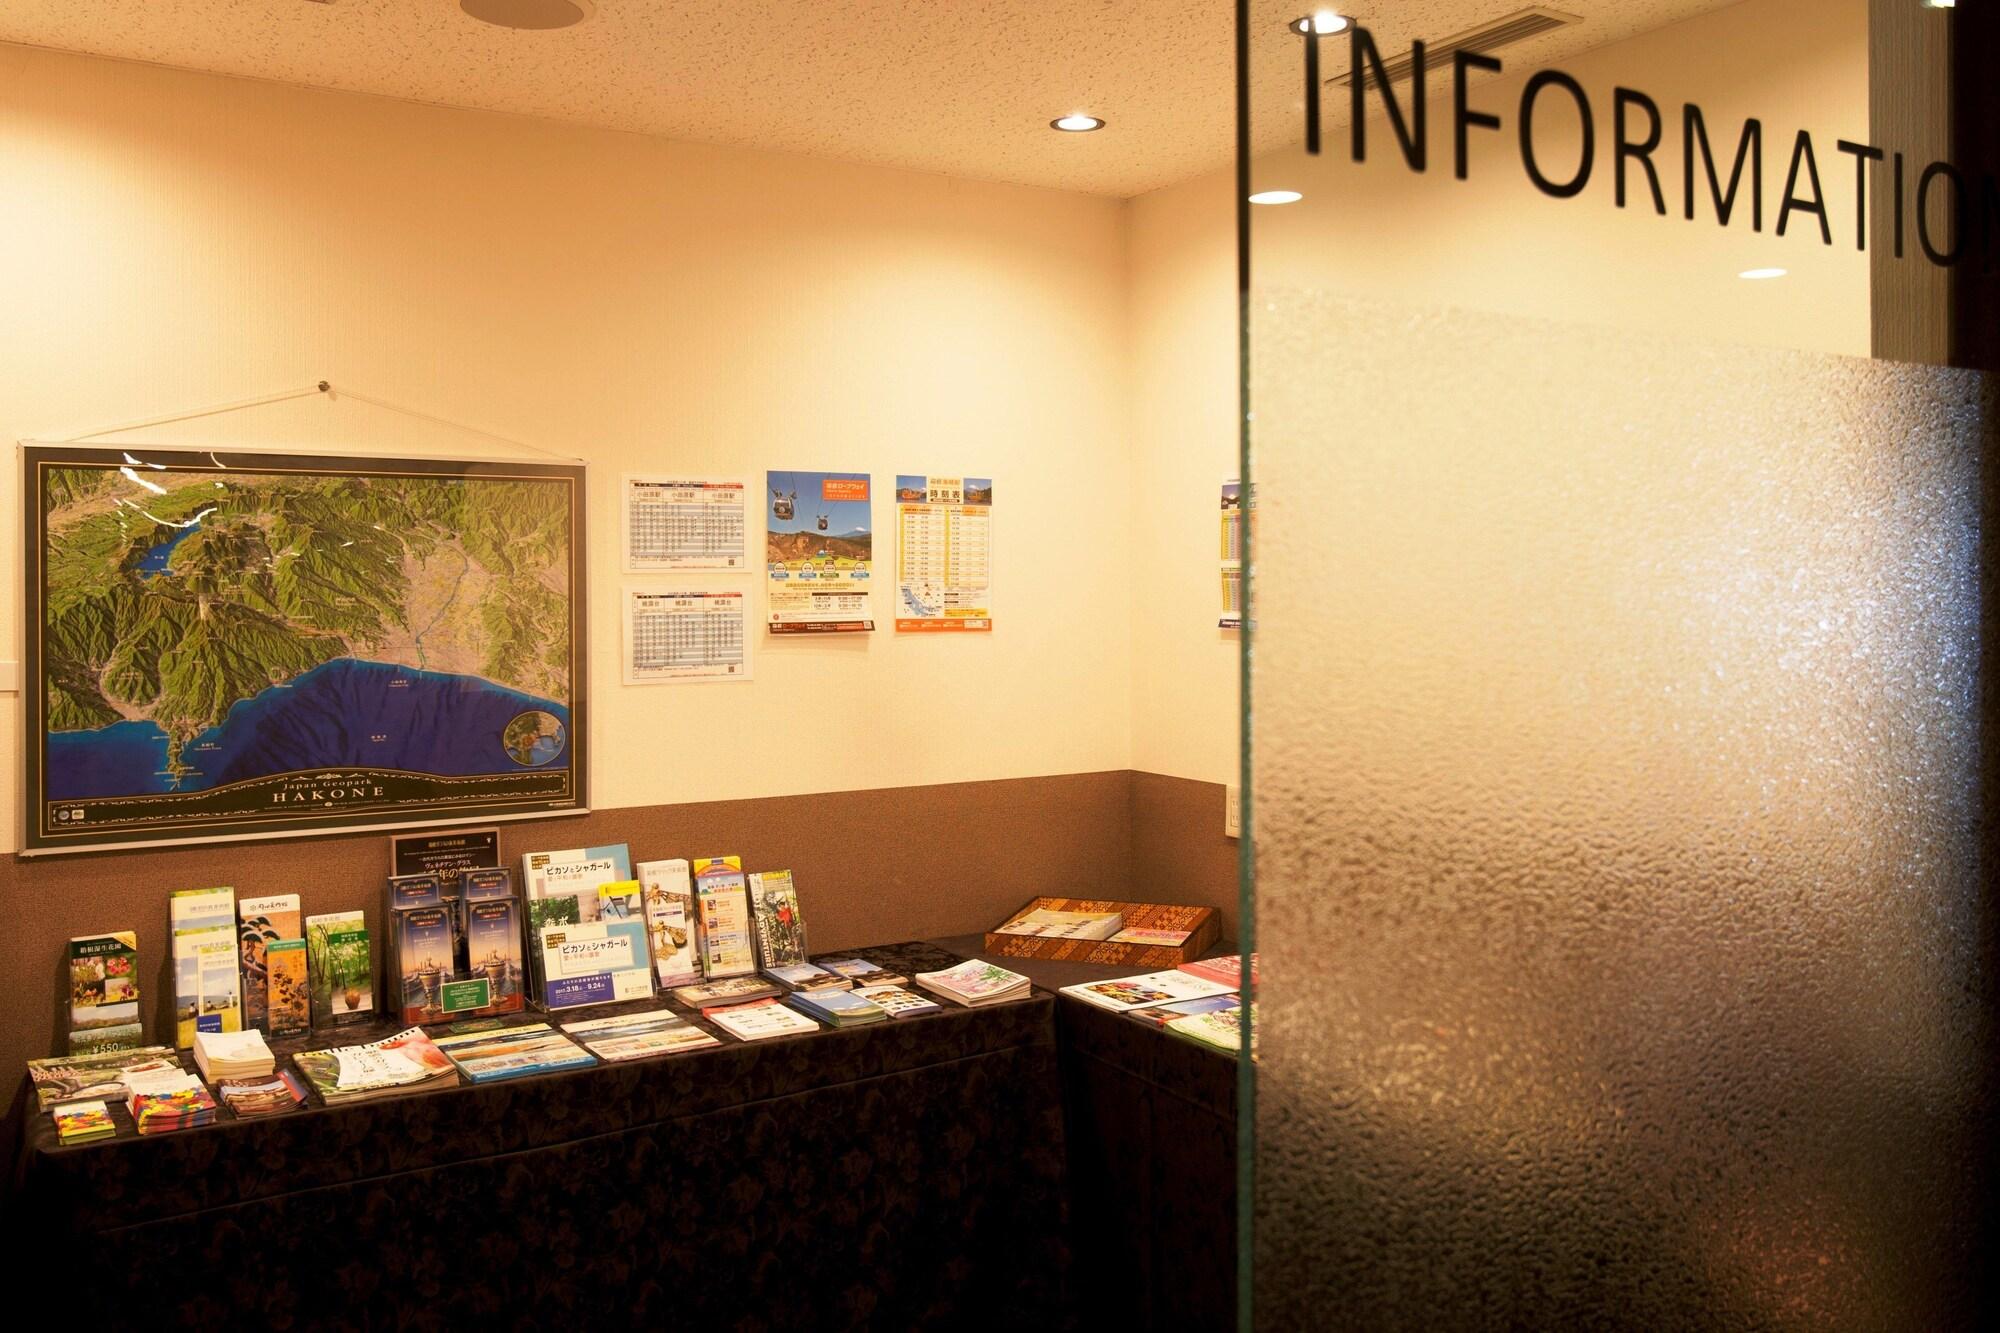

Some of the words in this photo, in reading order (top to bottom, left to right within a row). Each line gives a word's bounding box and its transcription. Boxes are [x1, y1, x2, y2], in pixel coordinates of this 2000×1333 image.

[929, 489, 961, 498] 時刻表
[283, 782, 317, 791] Japan
[323, 778, 373, 787] Geopark
[273, 786, 384, 803] HAKONE
[546, 861, 611, 876] ピカソとシャガール
[562, 939, 628, 954] ピカソとシャガール
[757, 913, 773, 968] ADVENTURE
